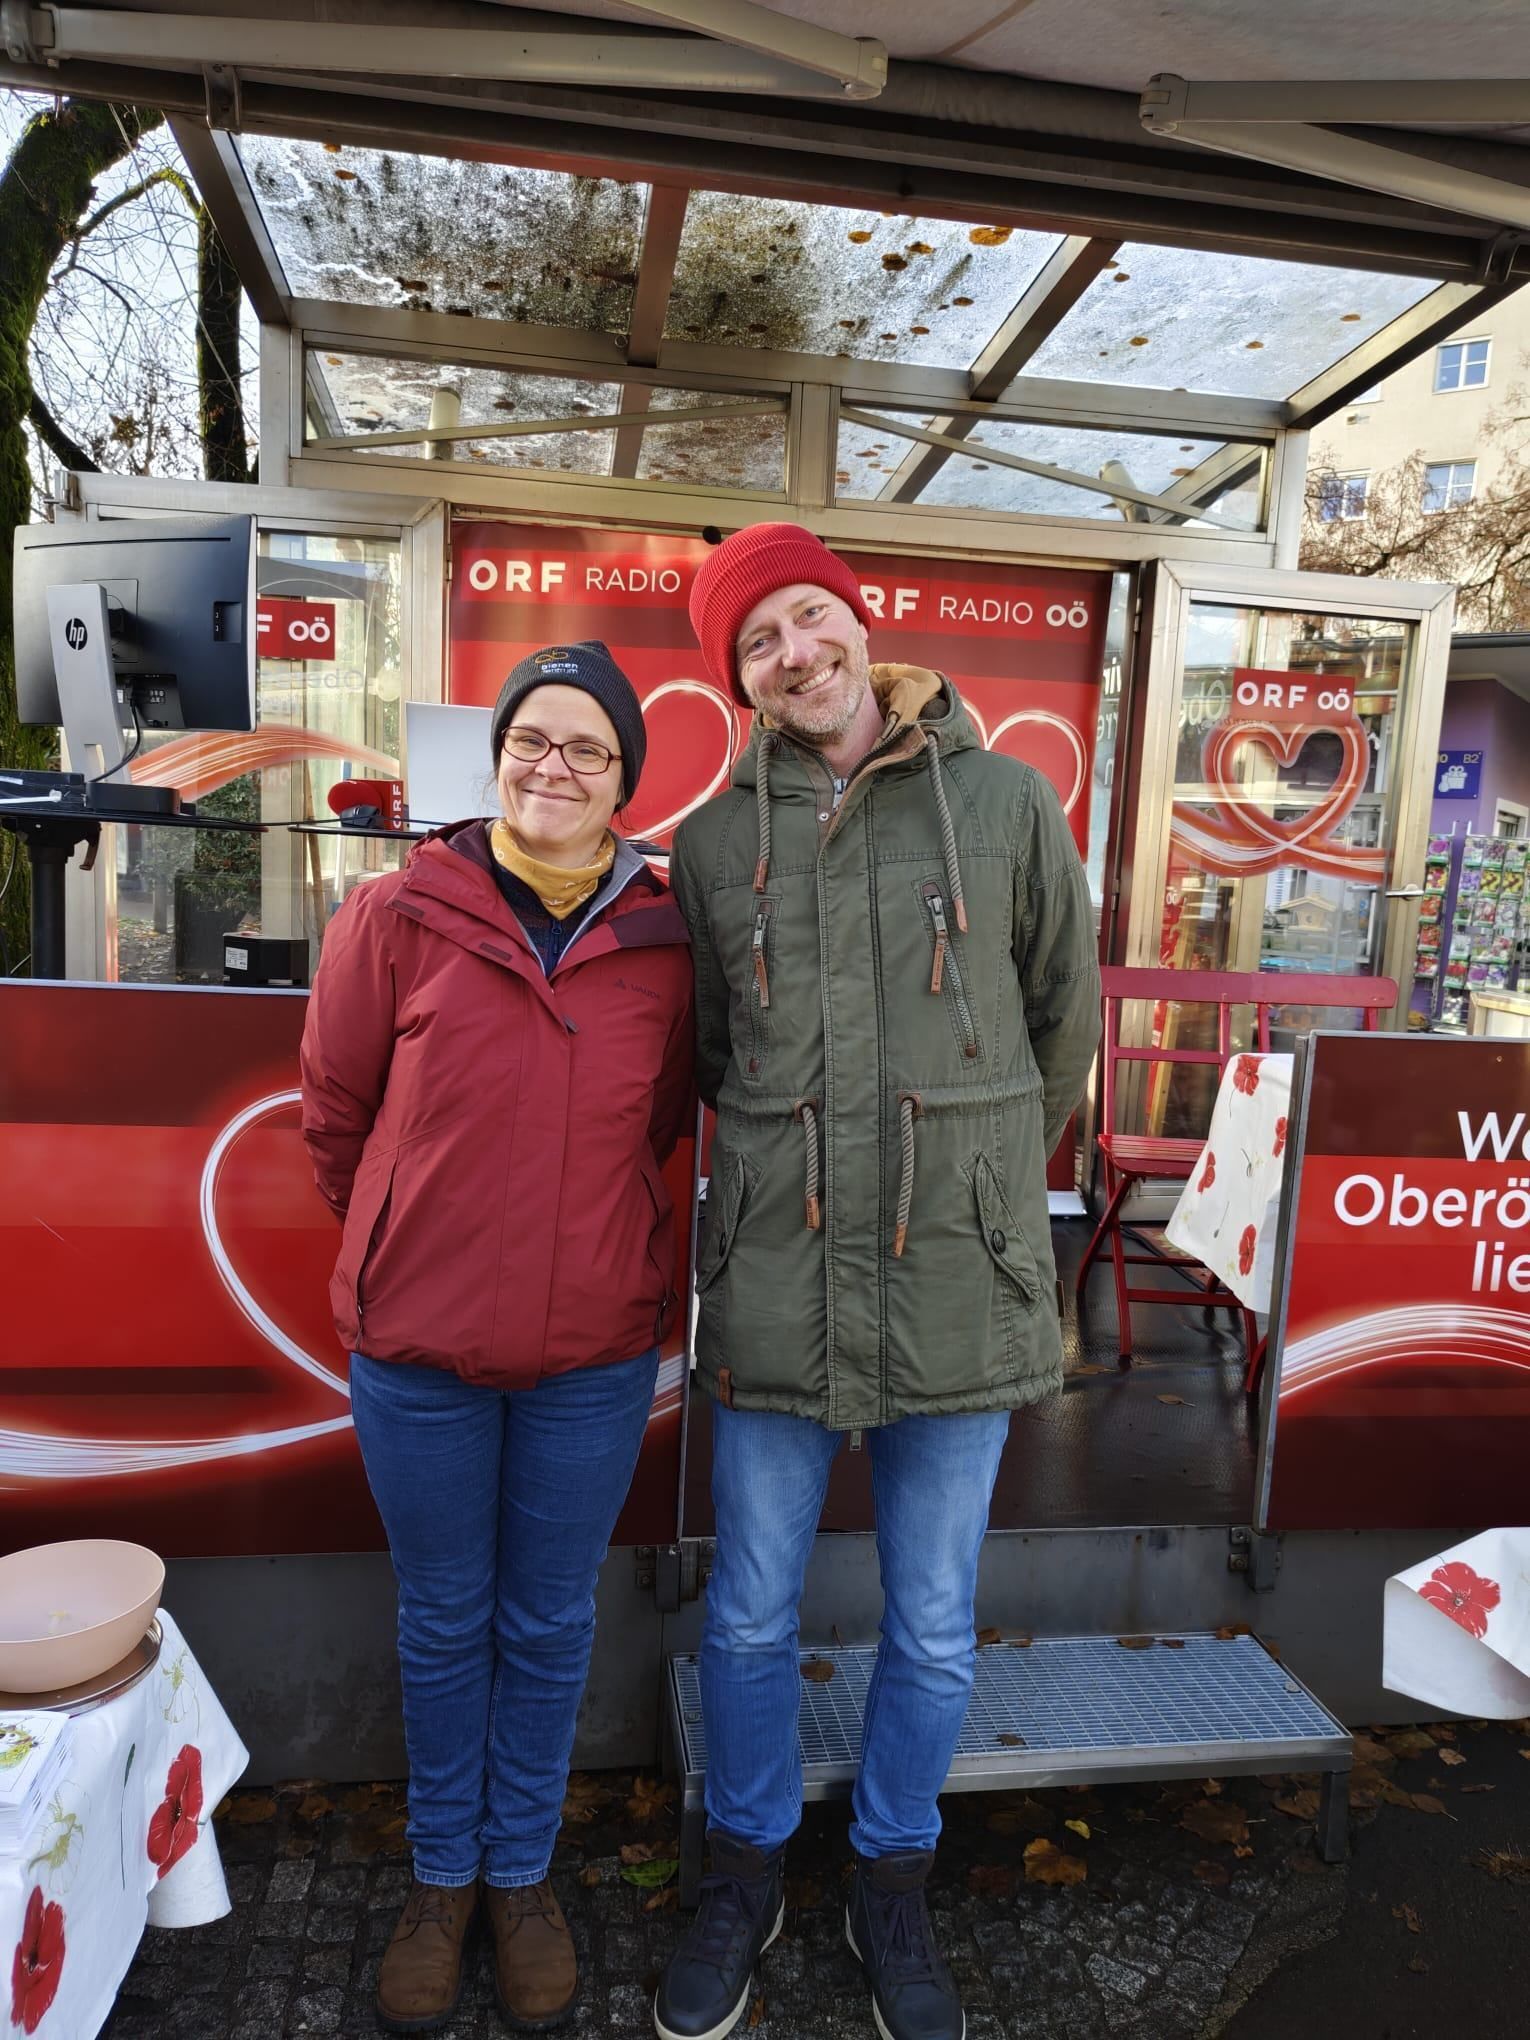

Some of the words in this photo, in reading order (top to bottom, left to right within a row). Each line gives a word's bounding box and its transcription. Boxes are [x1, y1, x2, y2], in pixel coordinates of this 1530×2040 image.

[469, 559, 566, 592] ORF
[586, 568, 681, 592] RADIO
[859, 585, 920, 620] RF
[939, 596, 1033, 625] RADIO
[69, 618, 85, 650] hp
[1236, 681, 1307, 709] ORF
[1463, 753, 1480, 764] B2
[392, 784, 402, 829] ORF
[1334, 1173, 1530, 1229] Oberö
[1471, 1240, 1530, 1293] lie
